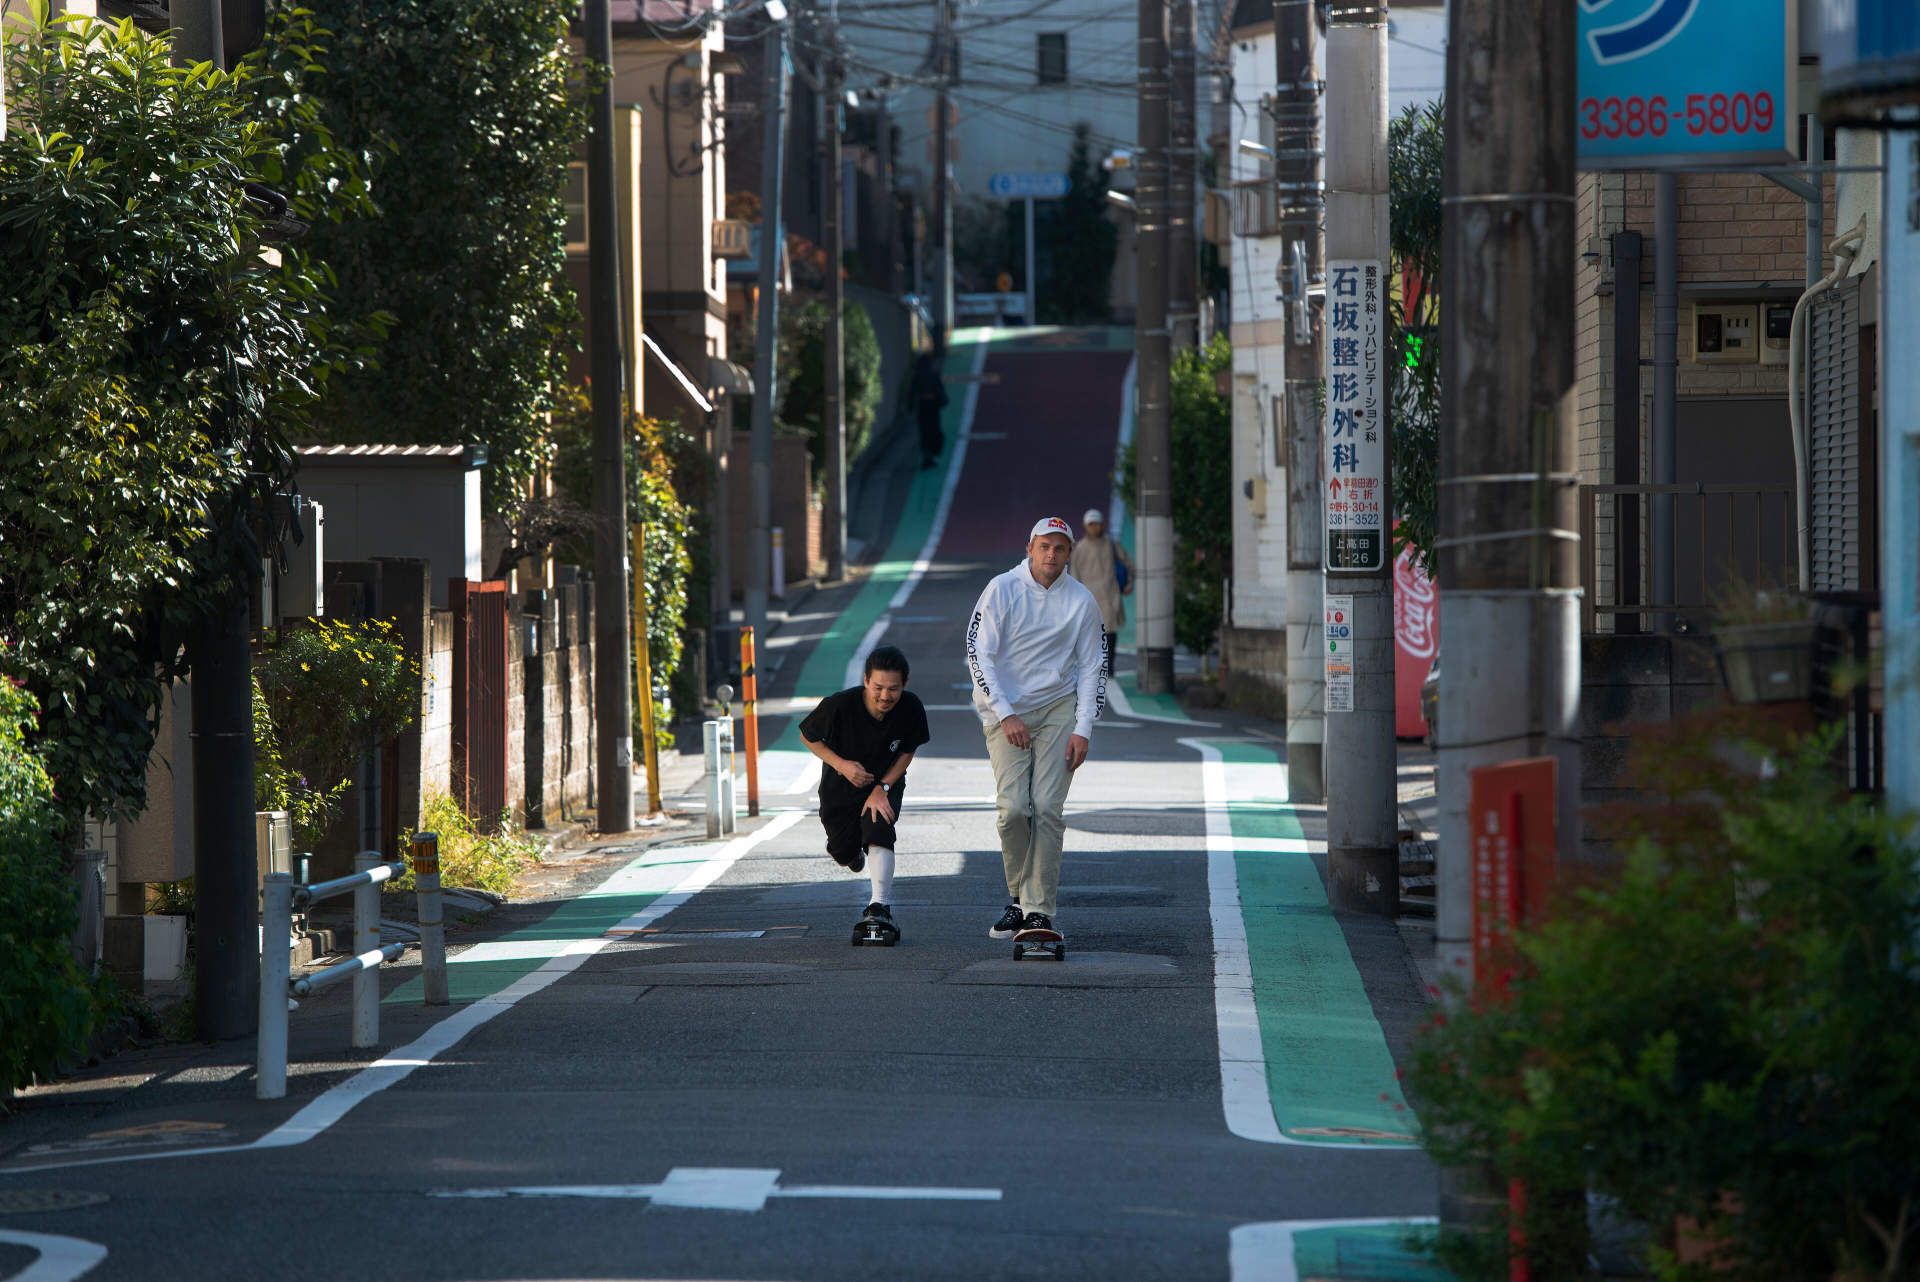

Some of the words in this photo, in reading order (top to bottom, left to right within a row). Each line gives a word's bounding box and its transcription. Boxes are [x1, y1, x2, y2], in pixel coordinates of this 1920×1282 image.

[1580, 91, 1774, 139] 3386-5809
[1332, 265, 1360, 473] 石坂整形外科
[1329, 513, 1379, 525] 3361-3522
[1336, 538, 1369, 549] 上高田
[1337, 553, 1369, 564] 1-26
